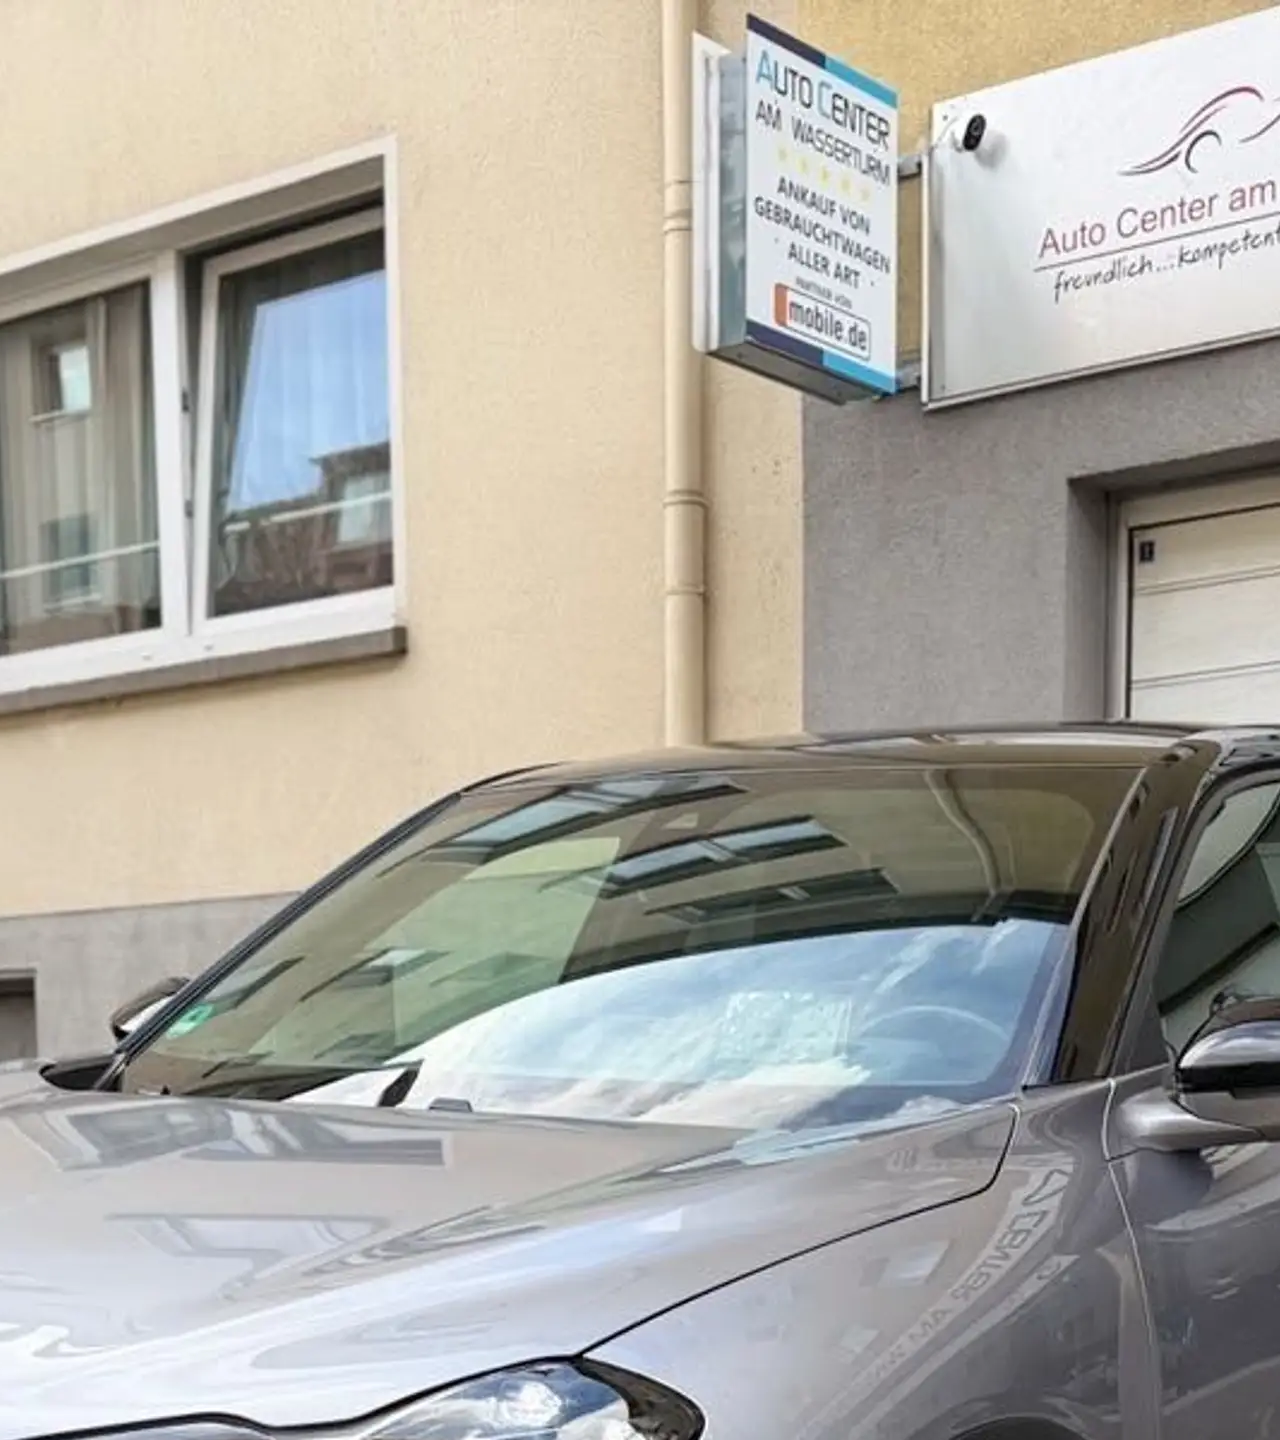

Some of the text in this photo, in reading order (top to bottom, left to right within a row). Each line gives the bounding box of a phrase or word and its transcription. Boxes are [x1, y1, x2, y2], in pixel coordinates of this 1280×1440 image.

[755, 50, 890, 151] AUTO CENTER
[756, 100, 890, 185] AM WASSERTURM
[754, 196, 890, 274] GEBRAUCHTWAGEN
[777, 176, 871, 235] ANKAUF VON
[1039, 222, 1106, 258] Auto
[1116, 193, 1219, 238] Center
[1228, 180, 1276, 213] am
[788, 242, 860, 289] ALLER ART
[789, 301, 867, 351] mobile.de
